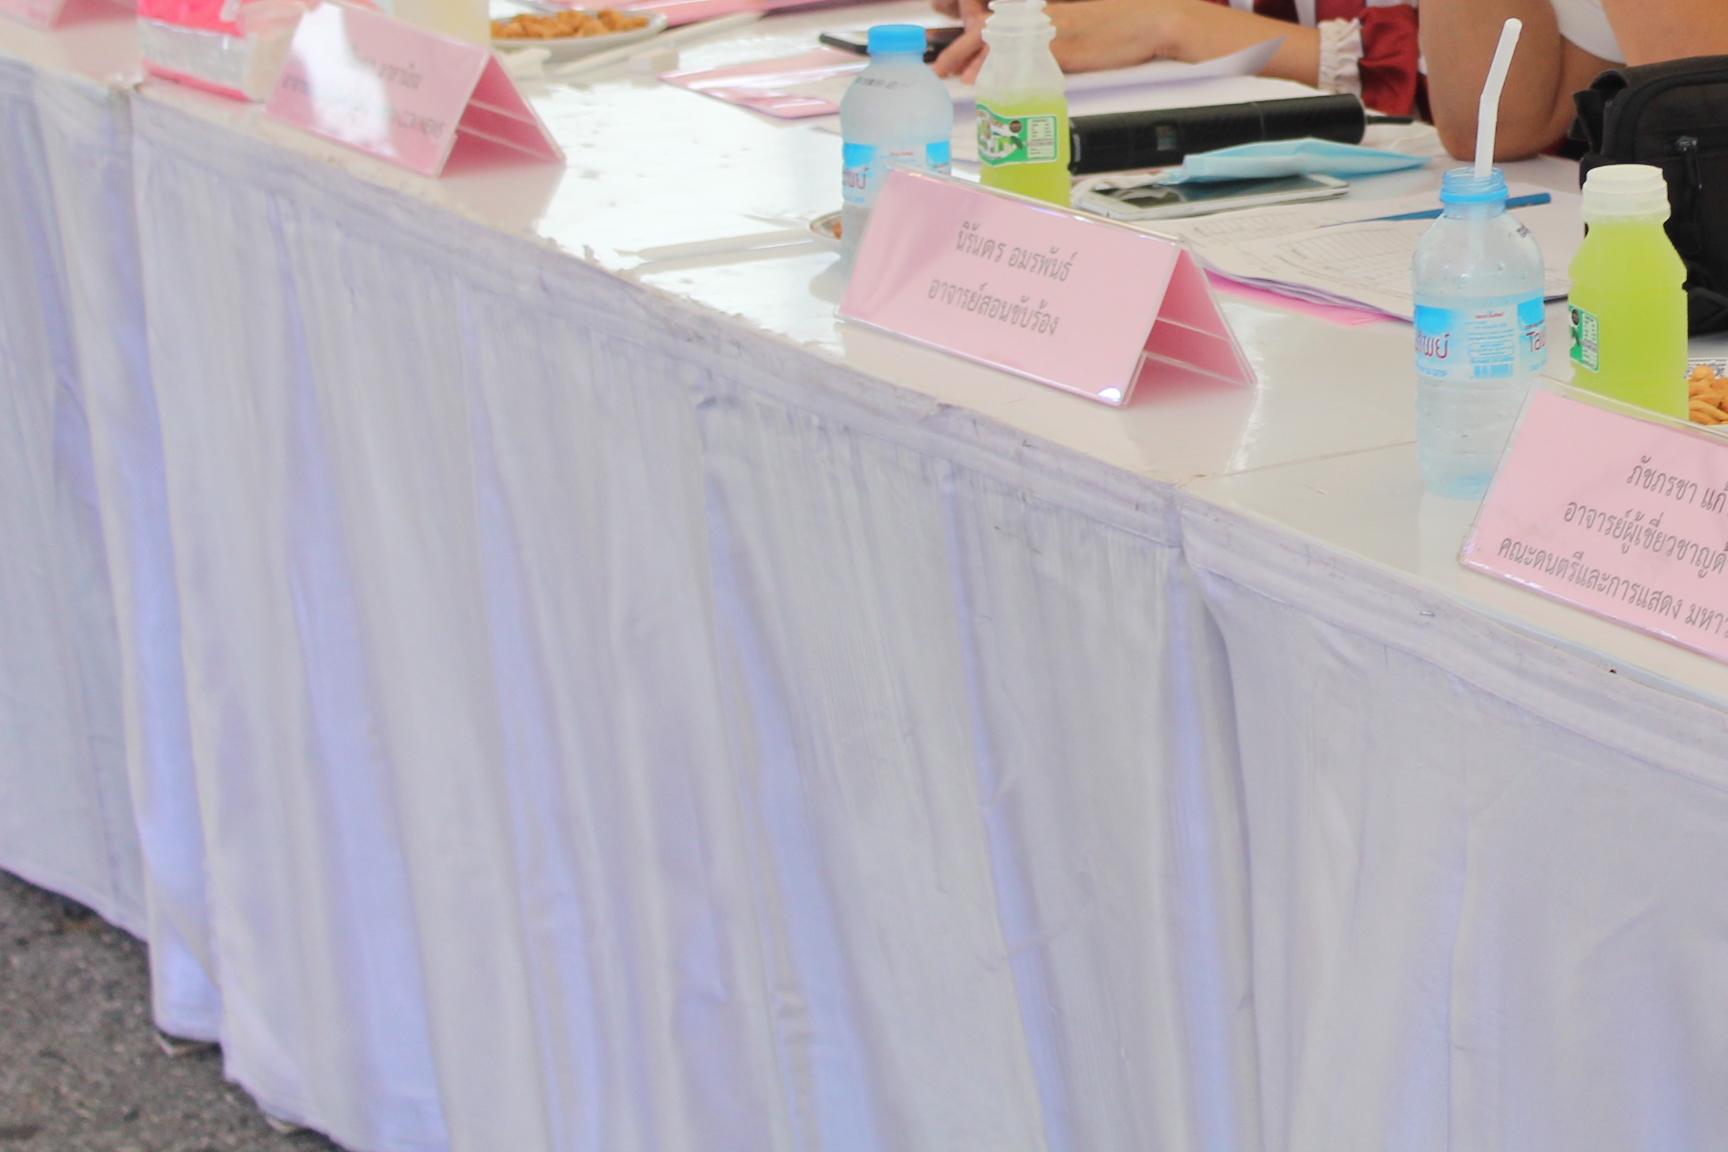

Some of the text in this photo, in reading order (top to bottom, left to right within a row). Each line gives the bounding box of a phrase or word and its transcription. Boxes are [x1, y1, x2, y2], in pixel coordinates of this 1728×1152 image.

[927, 279, 1060, 336] อาจารย์สอนขับร้อง
[1498, 538, 1683, 619] คณะดนตรีและการแสดง
